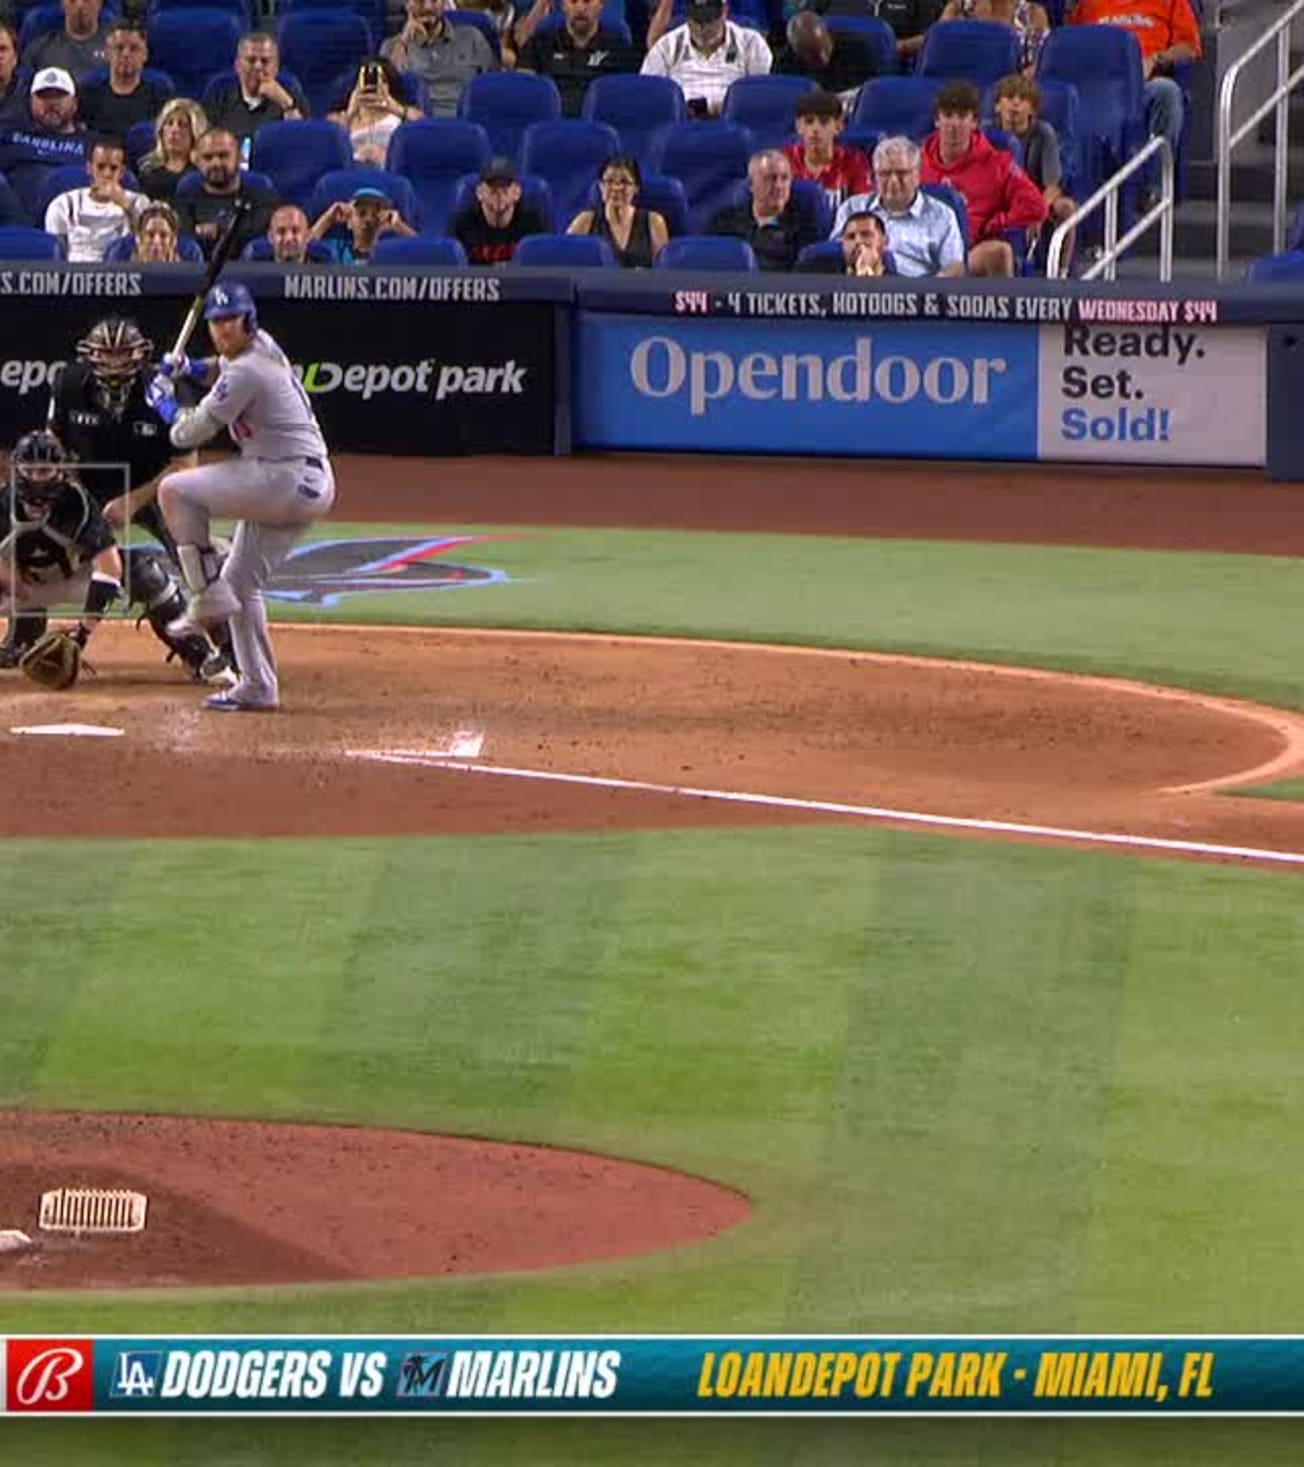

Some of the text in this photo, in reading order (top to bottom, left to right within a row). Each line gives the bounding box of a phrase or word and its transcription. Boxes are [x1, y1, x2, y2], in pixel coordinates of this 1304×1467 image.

[284, 275, 500, 301] MARLINS.COM/OFFERS
[728, 293, 741, 314] 4
[747, 293, 826, 318] TICKETS,
[924, 294, 940, 315] &
[1015, 298, 1073, 319] EVERY
[1078, 299, 1177, 322] WEDNESDAY
[1062, 322, 1206, 365] Ready.
[435, 360, 526, 400] park
[630, 335, 1008, 416] Opendoor
[1061, 366, 1143, 400] Set.
[1060, 407, 1170, 441] Sold!
